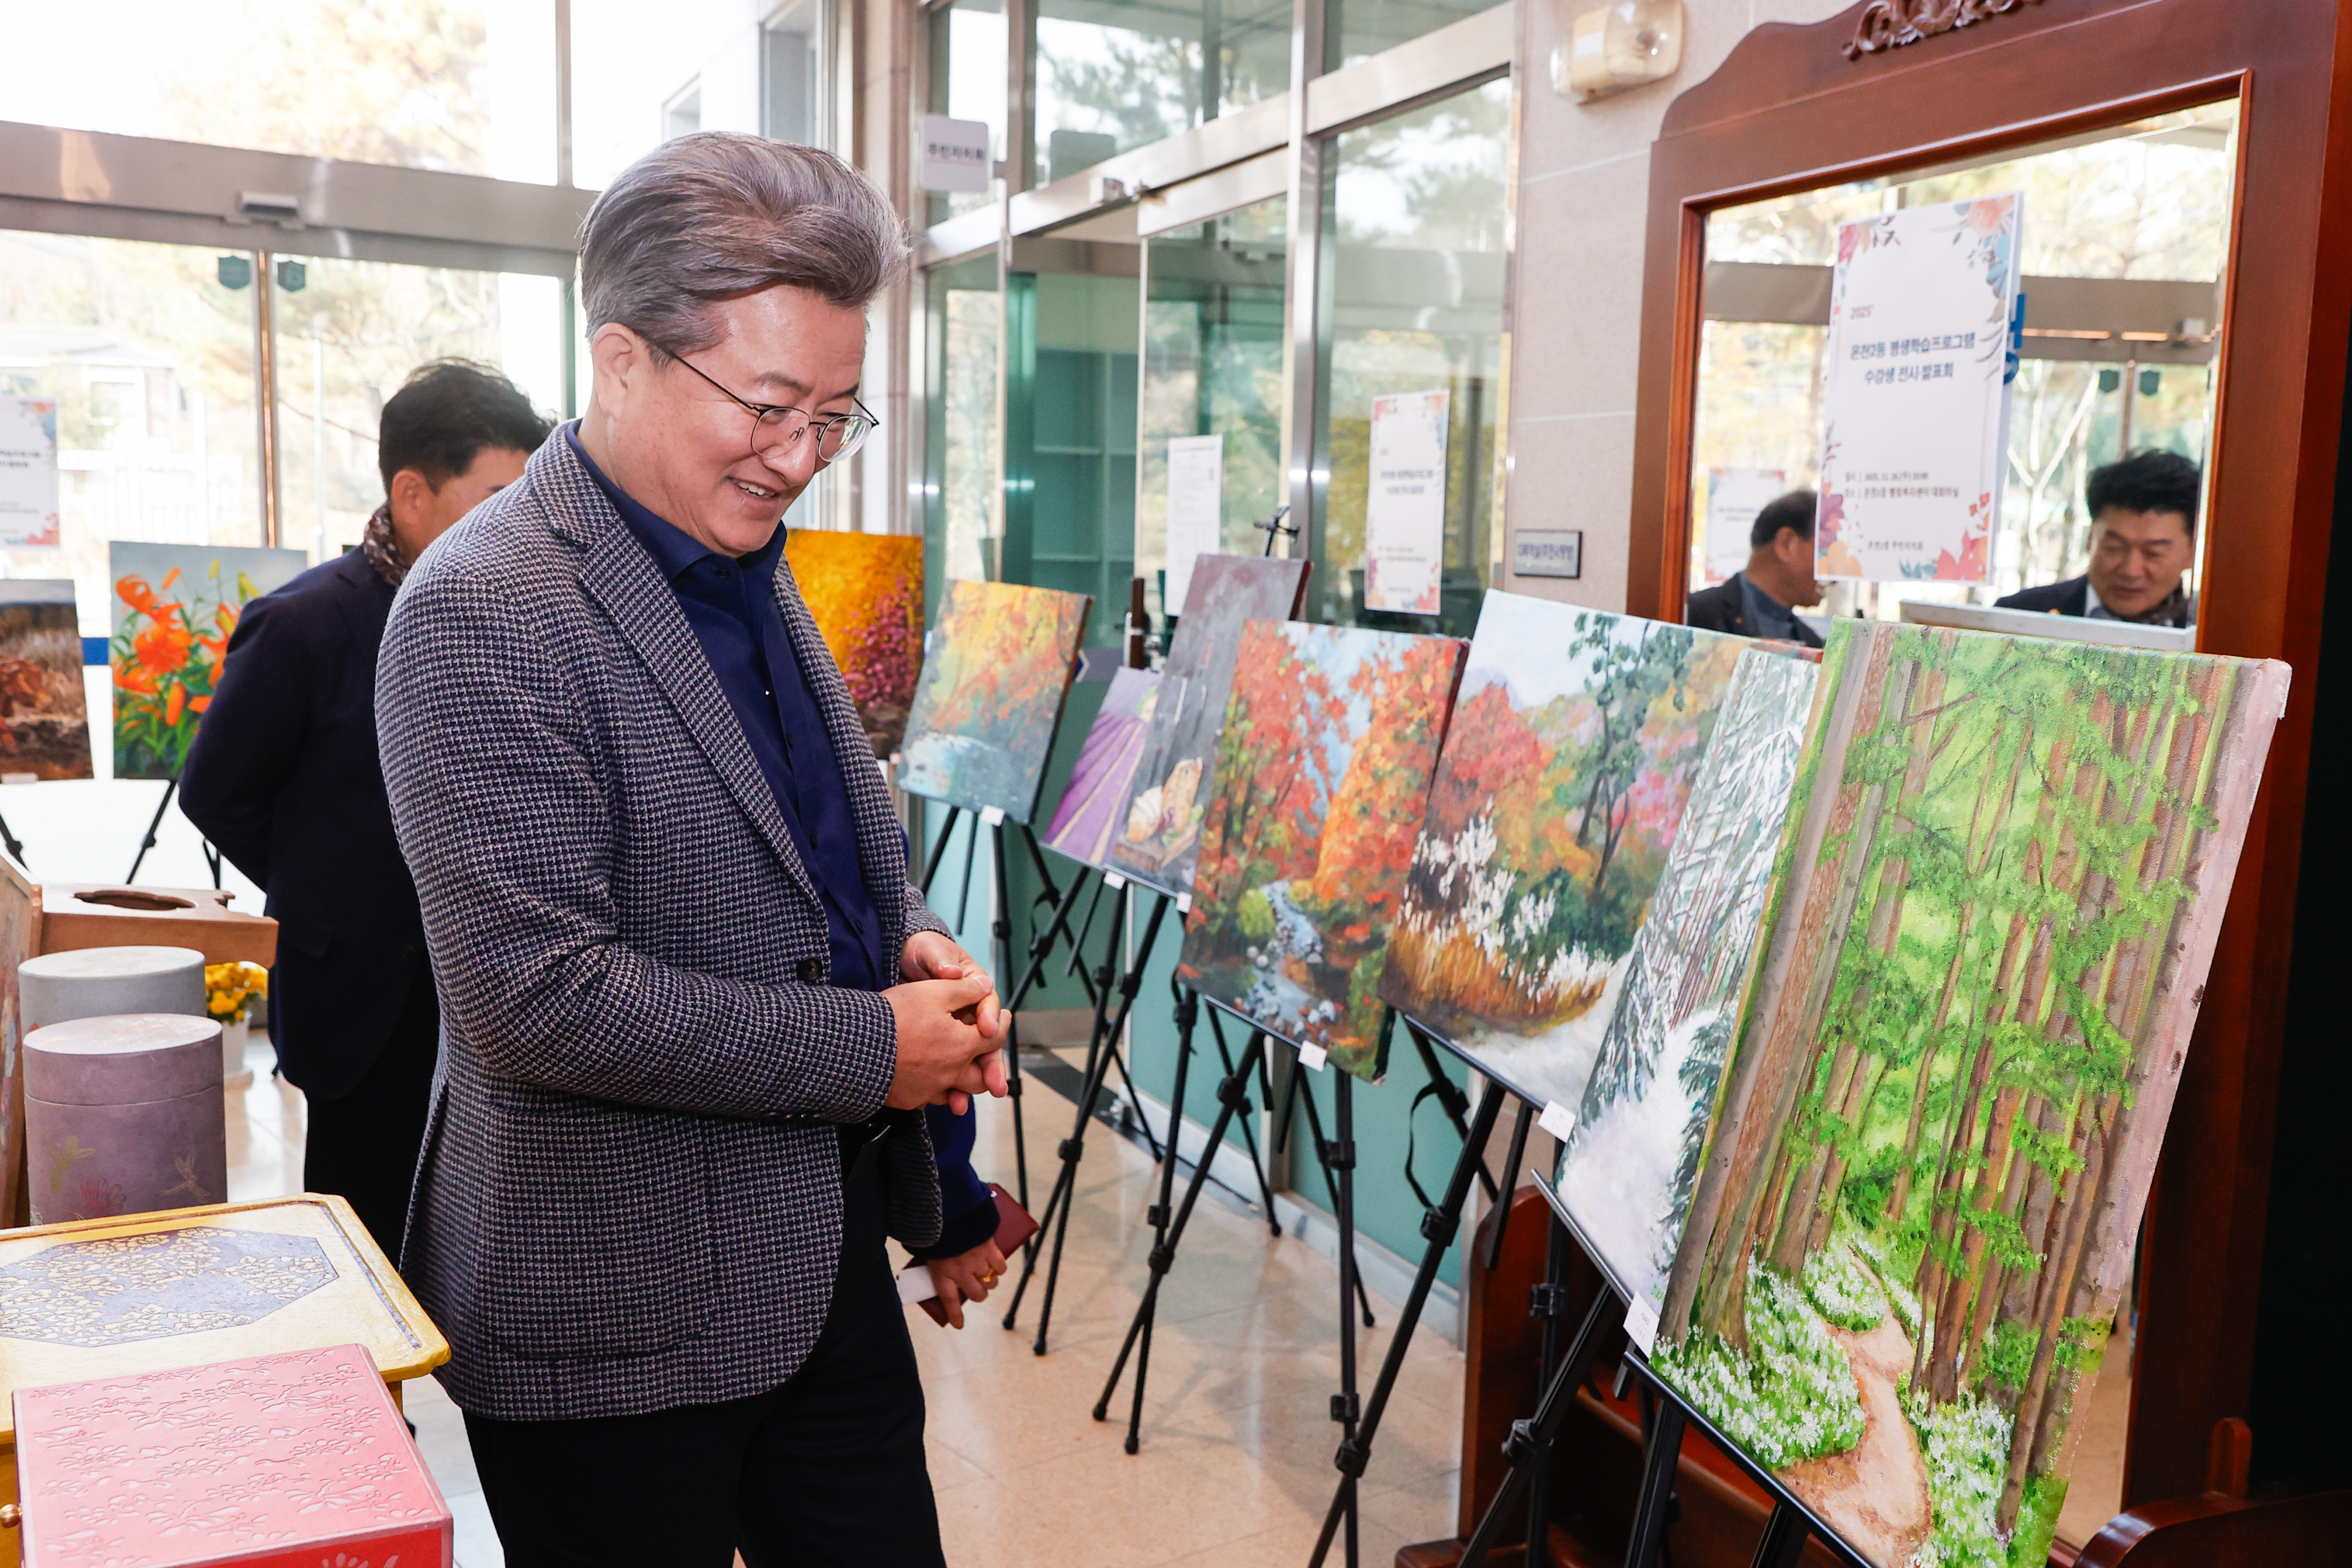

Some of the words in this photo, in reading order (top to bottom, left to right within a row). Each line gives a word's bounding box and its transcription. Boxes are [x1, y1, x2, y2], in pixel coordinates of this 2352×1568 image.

[1890, 332, 1975, 357] 평생학습프로그램
[1865, 367, 1895, 385] 수강생
[1922, 362, 1954, 380] 발표회
